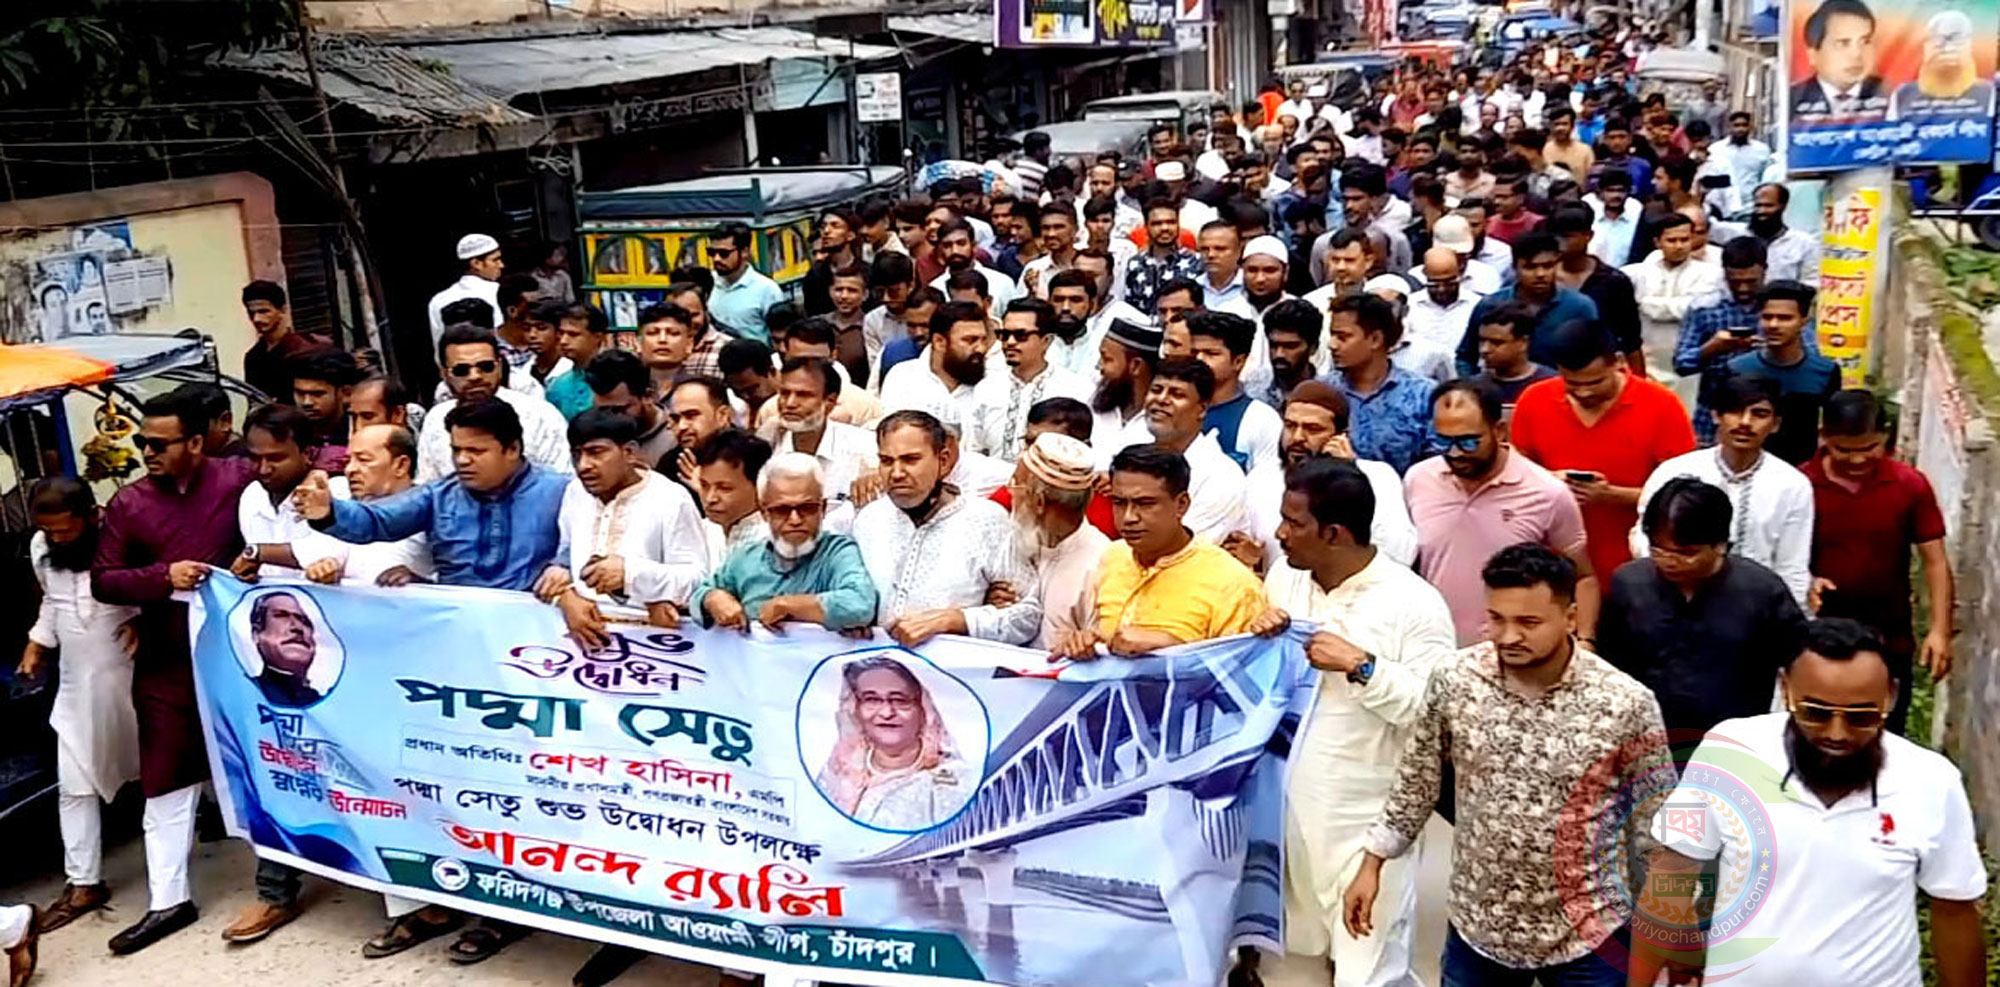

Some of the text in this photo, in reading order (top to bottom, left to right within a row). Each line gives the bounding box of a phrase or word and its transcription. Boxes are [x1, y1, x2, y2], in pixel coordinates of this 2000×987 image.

[396, 680, 752, 766] পদ্মা সেতু
[327, 789, 407, 820] উন্মোচন
[404, 738, 445, 754] প্রধান
[529, 752, 609, 776] শেখ
[623, 758, 743, 801] হাসিনা,
[393, 777, 824, 864] পদ্মা সেতু শুভ উদ্বোধন উপলক্ষে
[440, 819, 647, 886] আনন্দ
[475, 870, 565, 911] ফরিদগঞ্জ
[565, 890, 656, 931] উপজেলা
[660, 912, 756, 949] আওয়ামী
[828, 929, 916, 970] চাঁদপুর
